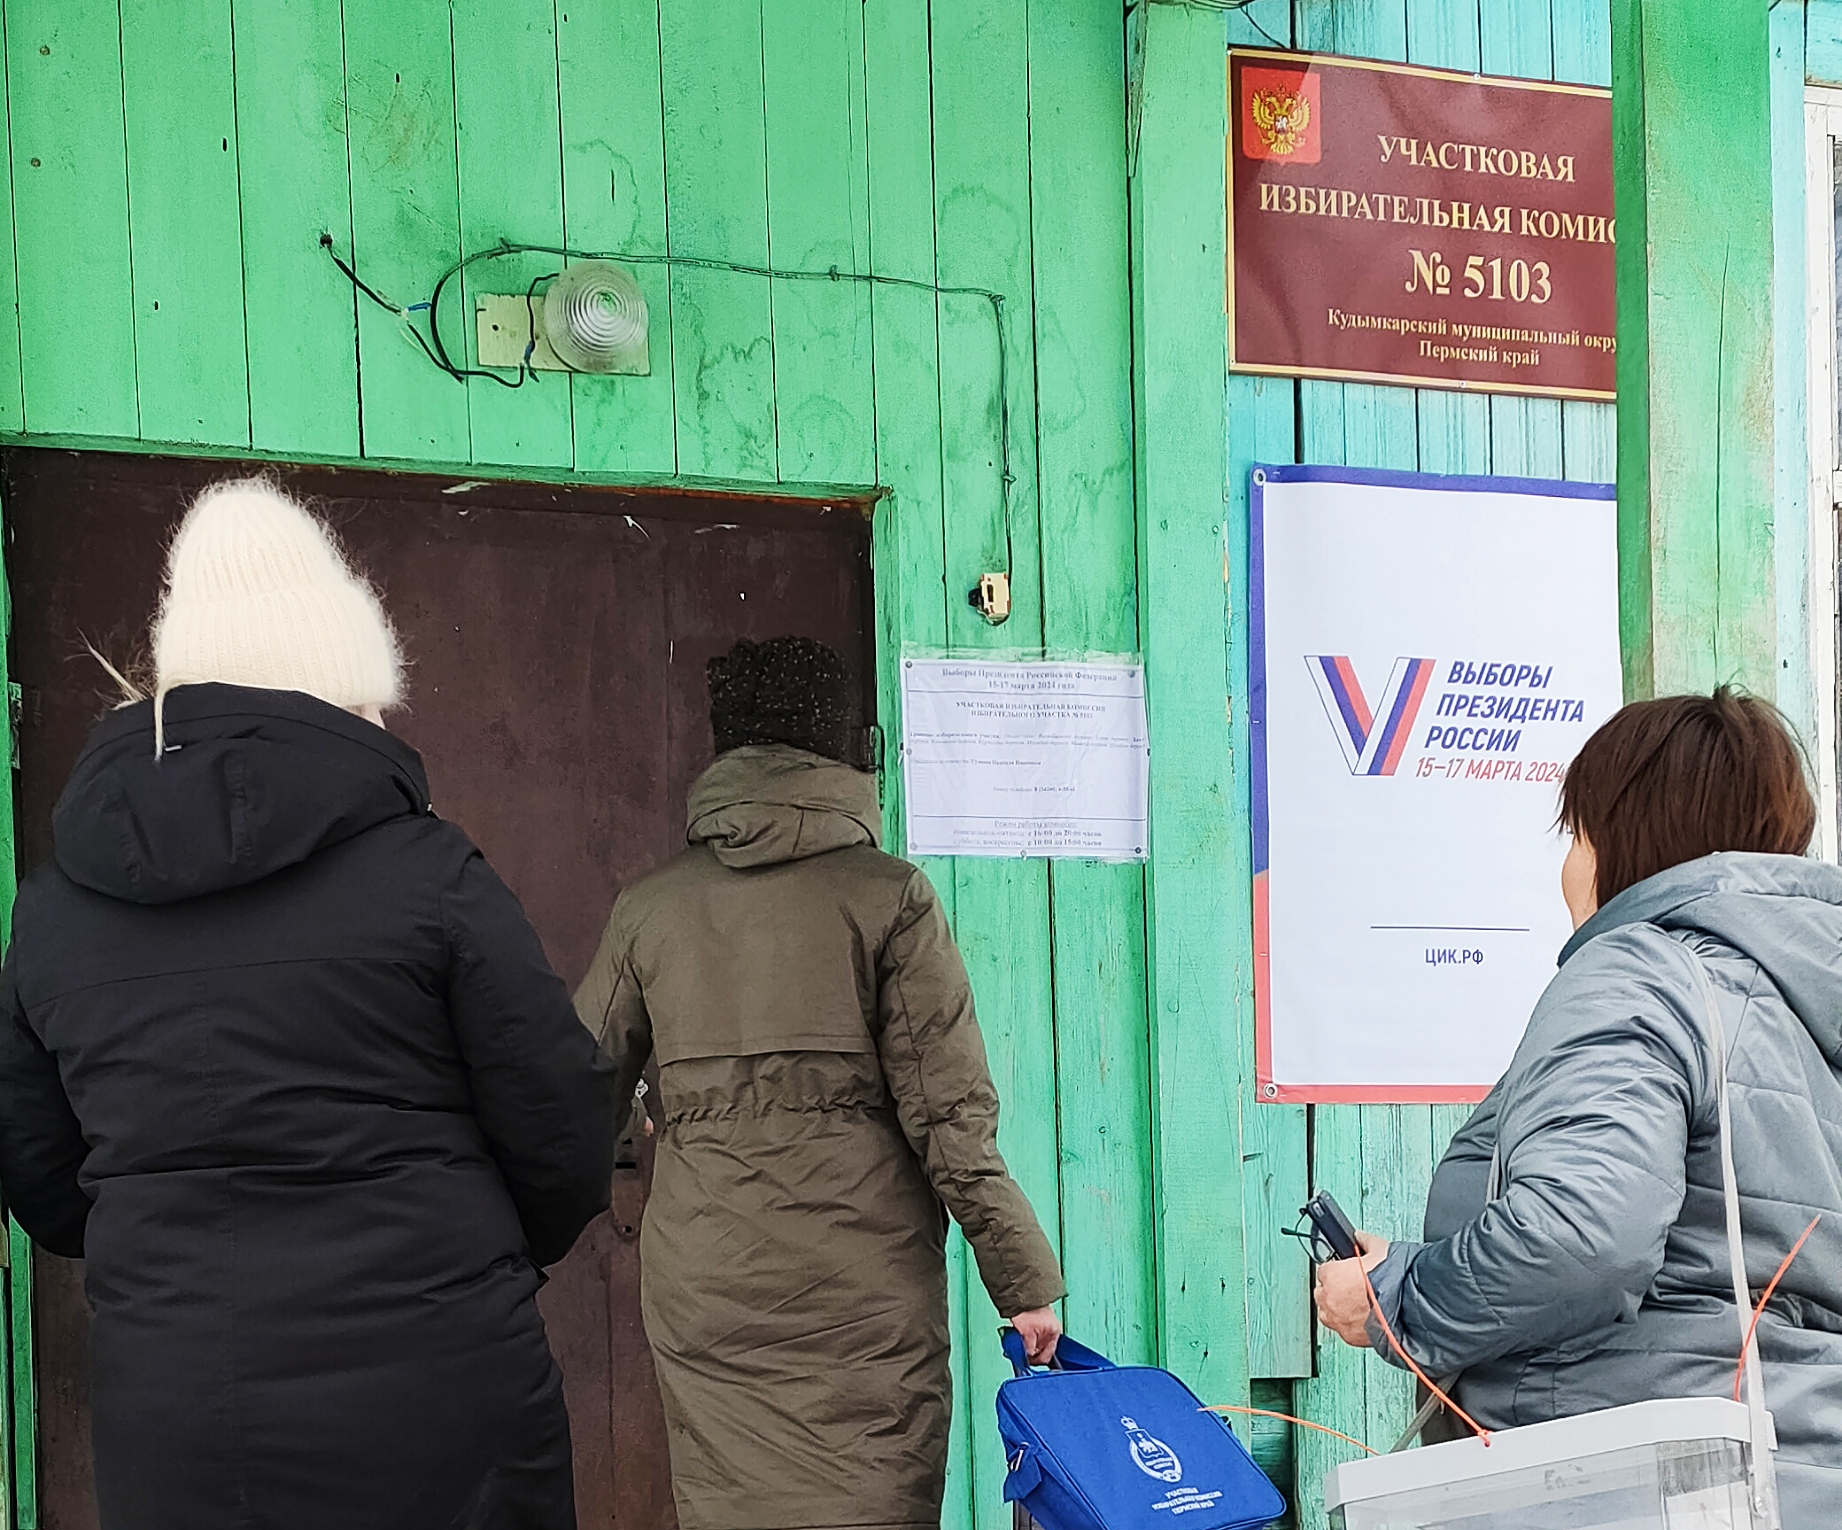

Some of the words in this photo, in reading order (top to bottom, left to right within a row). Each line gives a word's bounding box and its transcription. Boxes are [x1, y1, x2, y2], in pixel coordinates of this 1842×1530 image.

[1377, 135, 1576, 182] УЧАСТКОВАЯ
[1259, 183, 1512, 234] ИЗБИРАТЕЛЬНАЯ
[1405, 249, 1451, 295] №
[1463, 256, 1552, 304] 5103
[1328, 308, 1447, 336] Кудымкарский
[1452, 323, 1580, 347] муниципальный
[1419, 340, 1498, 364] Пермский
[1502, 348, 1541, 368] край
[989, 680, 1009, 689] 15-17
[1037, 681, 1056, 689] 2024
[1448, 660, 1553, 689] ВЫБОРЫ
[1436, 693, 1584, 724] ПРЕЗИДЕНТА
[1424, 725, 1522, 752] РОССИИ
[1465, 758, 1522, 781] МАРТА
[1525, 761, 1565, 782] 2024
[1425, 948, 1484, 966] ЦИК.РФ
